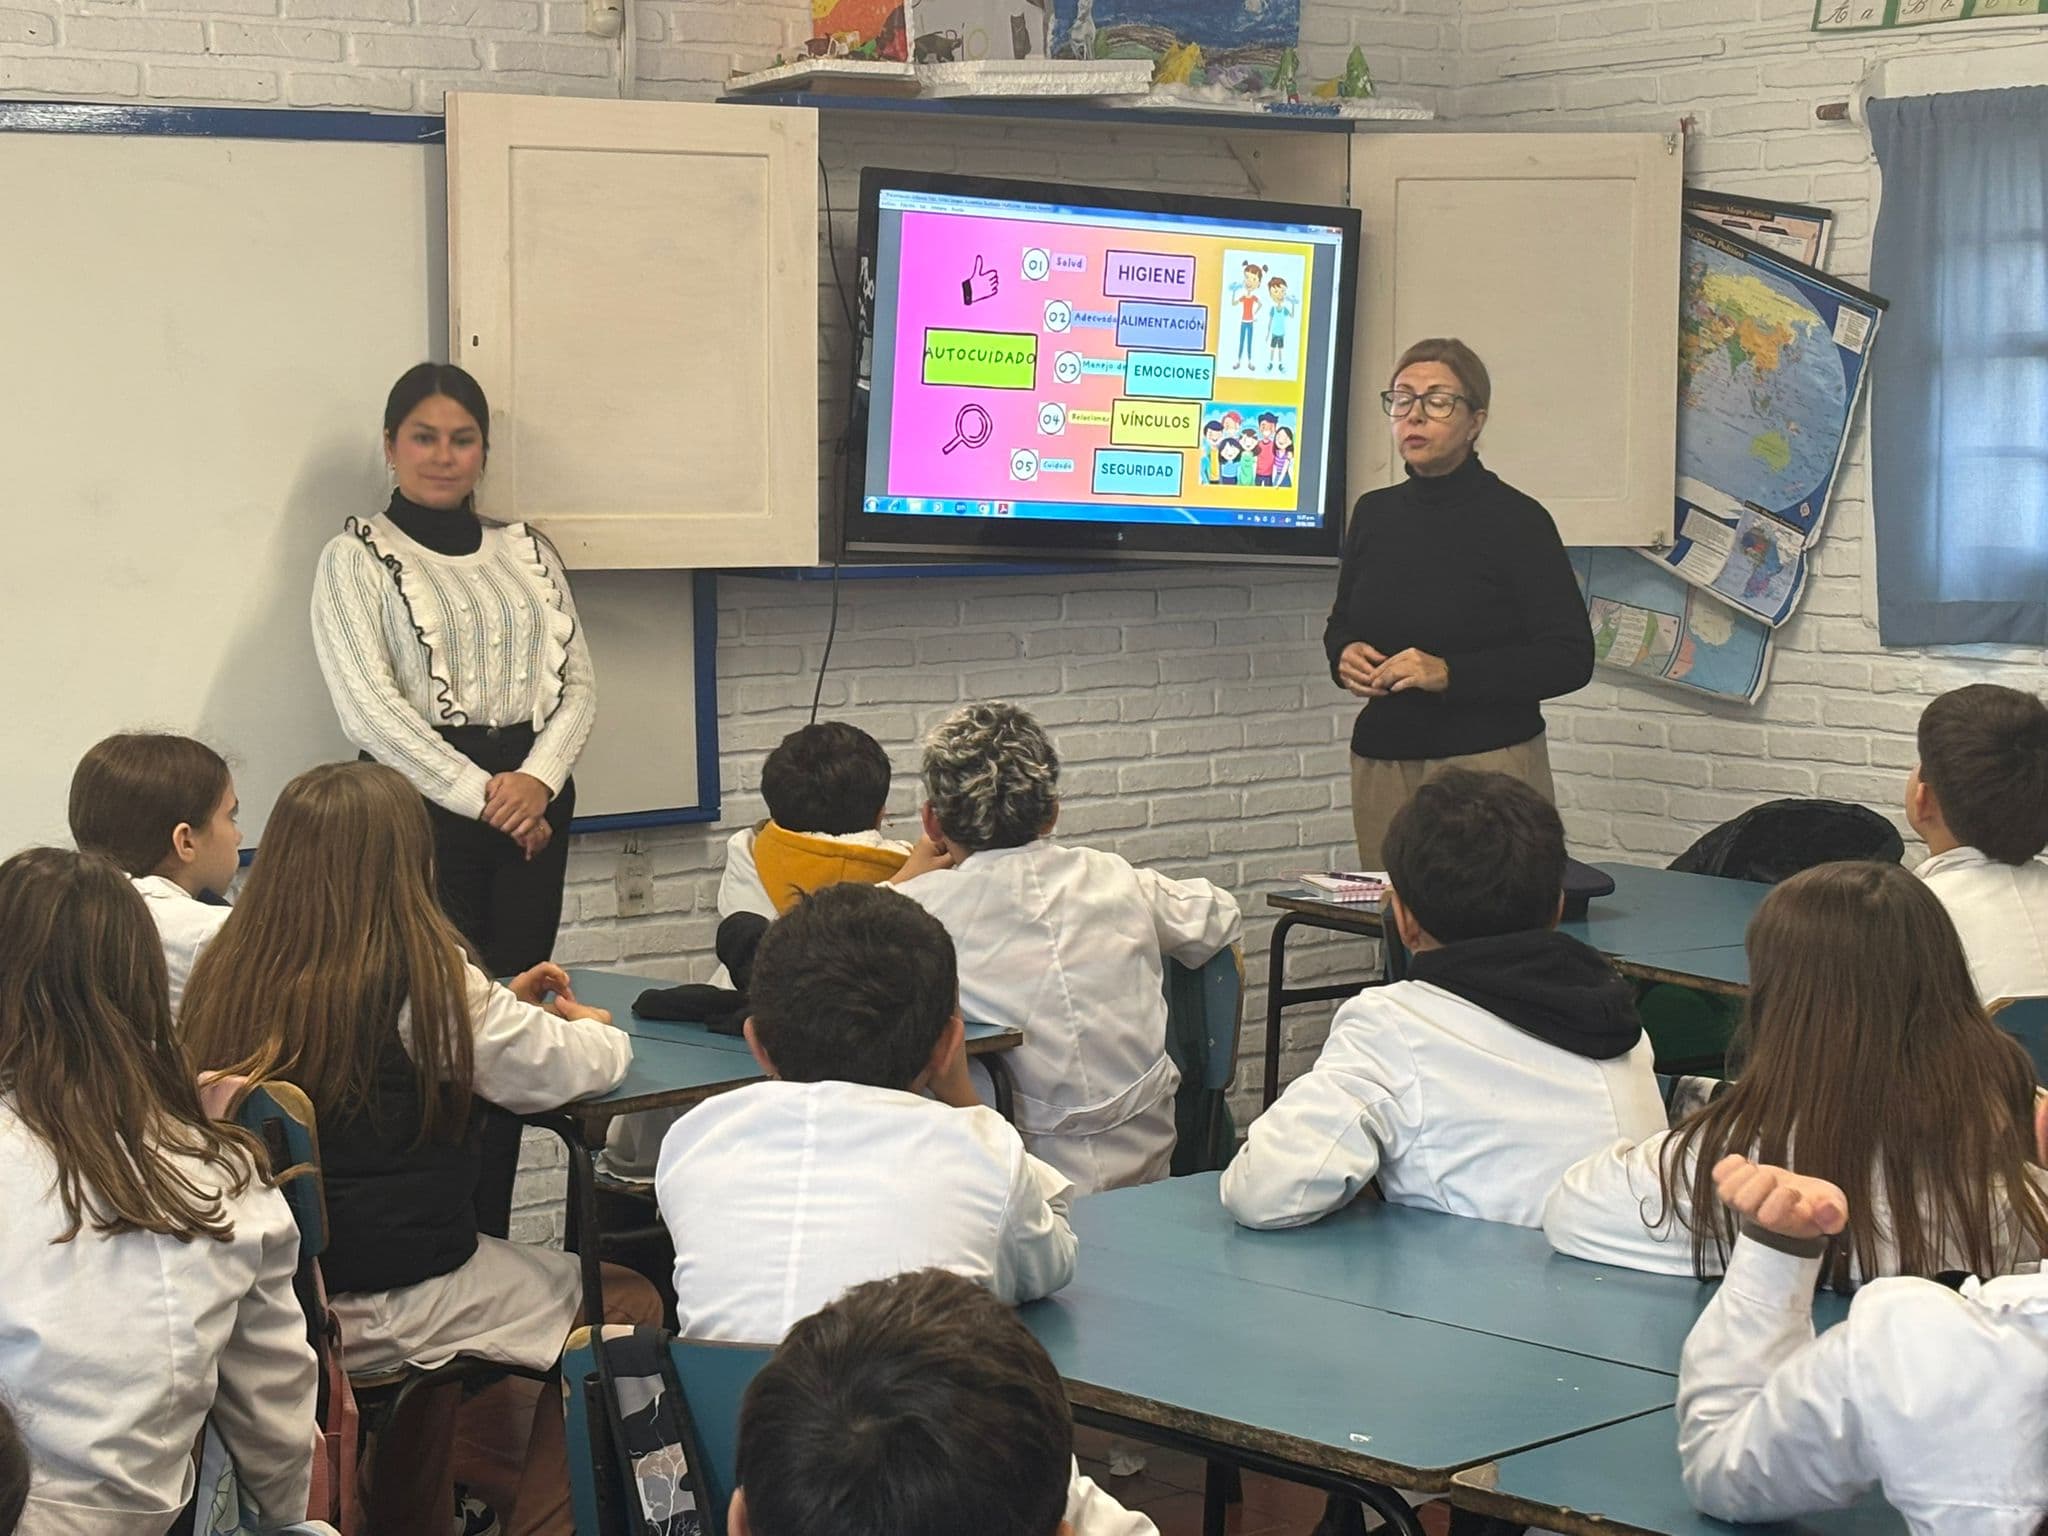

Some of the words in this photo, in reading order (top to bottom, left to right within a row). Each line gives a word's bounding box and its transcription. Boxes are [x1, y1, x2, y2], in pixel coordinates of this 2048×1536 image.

[1029, 259, 1043, 271] 01
[1056, 257, 1083, 269] Salud
[1118, 264, 1186, 285] HIGIENE
[1049, 312, 1066, 323] 02
[1120, 315, 1204, 330] ALIMENTACIÓN
[925, 346, 1036, 364] AUTOCUIDADO
[1059, 363, 1076, 374] 03
[1082, 361, 1113, 373] Manejo
[1134, 364, 1210, 381] EMOCIONES
[1043, 414, 1060, 425] 04
[1120, 410, 1191, 430] VÍNCULOS
[1015, 460, 1033, 471] 05
[1101, 463, 1174, 478] SEGURIDAD
